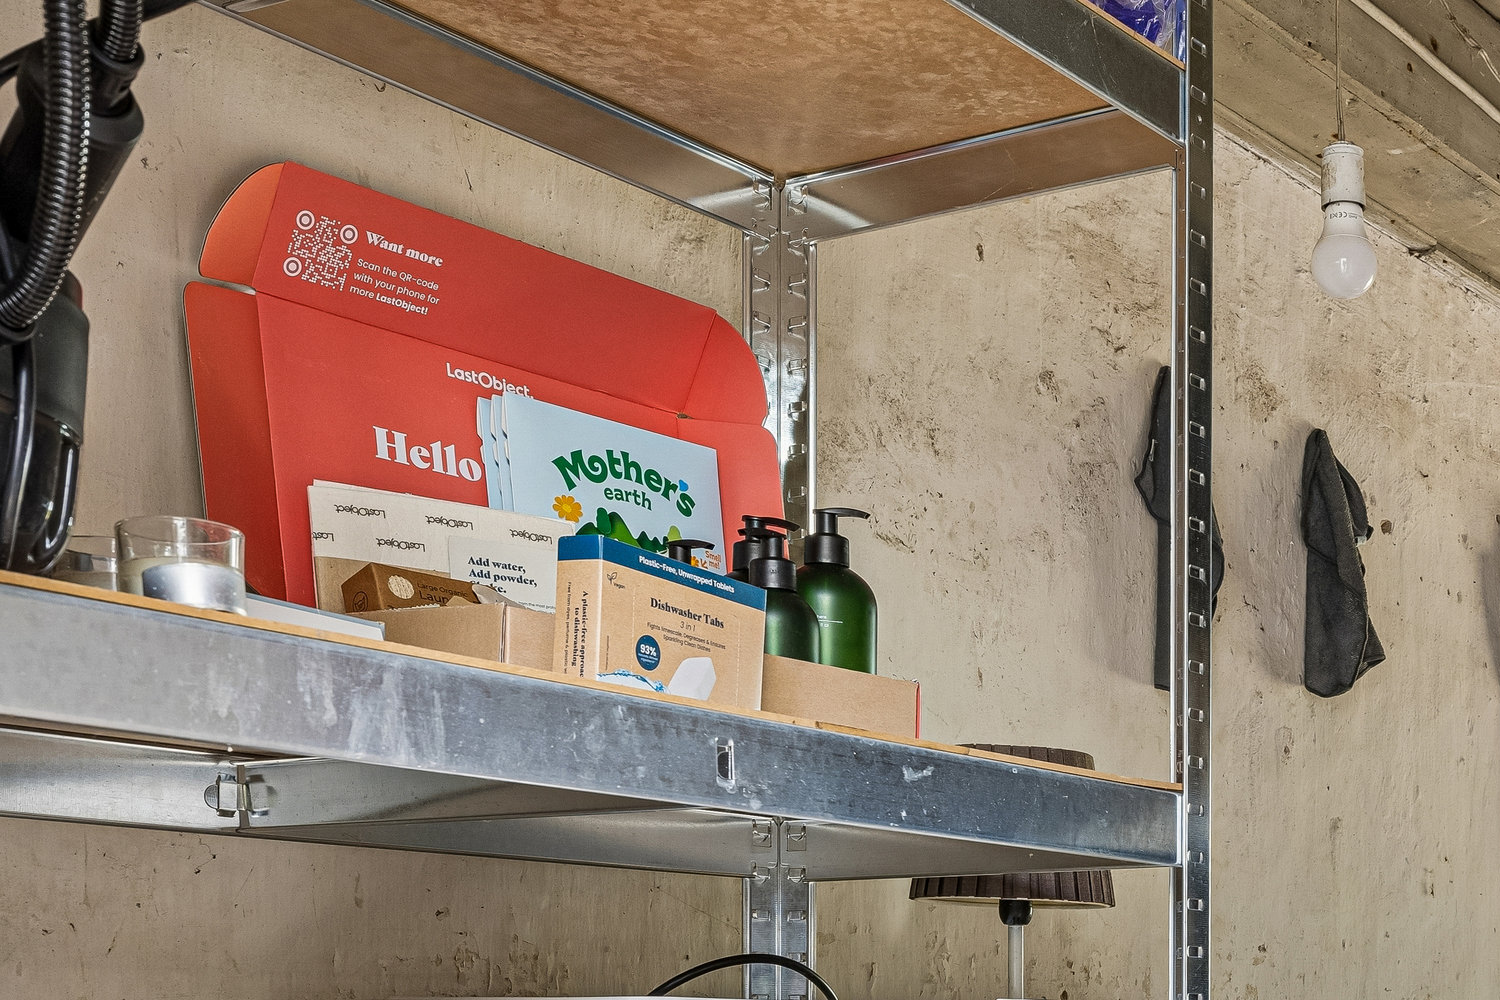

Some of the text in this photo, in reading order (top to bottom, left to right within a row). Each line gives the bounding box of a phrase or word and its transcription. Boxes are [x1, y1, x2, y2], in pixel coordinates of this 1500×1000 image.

[366, 230, 443, 267] Want more
[357, 258, 439, 290] Scan the QR-code
[354, 272, 440, 305] with your phone for
[350, 286, 428, 315] more LastObject!
[373, 426, 482, 482] Hello
[552, 450, 696, 517] Mother's
[604, 487, 652, 511] earth
[334, 504, 386, 518] LastObject
[425, 516, 473, 530] LastObject
[376, 538, 425, 552] LastObject
[510, 529, 552, 544] LastObject
[468, 556, 526, 574] Add water,
[705, 551, 721, 562] Smell
[469, 569, 537, 587] Add powder,
[639, 556, 734, 593] Plastic-Free, Unwrapped Tablets
[417, 581, 468, 598] Large Organic
[650, 598, 724, 628] Dishwasher Tabs
[572, 607, 580, 666] to dishwashing
[647, 622, 660, 631] Fights
[684, 632, 706, 644] Degreases
[663, 635, 710, 652] Sparkling Clean Dishes
[640, 644, 656, 656] 93%
